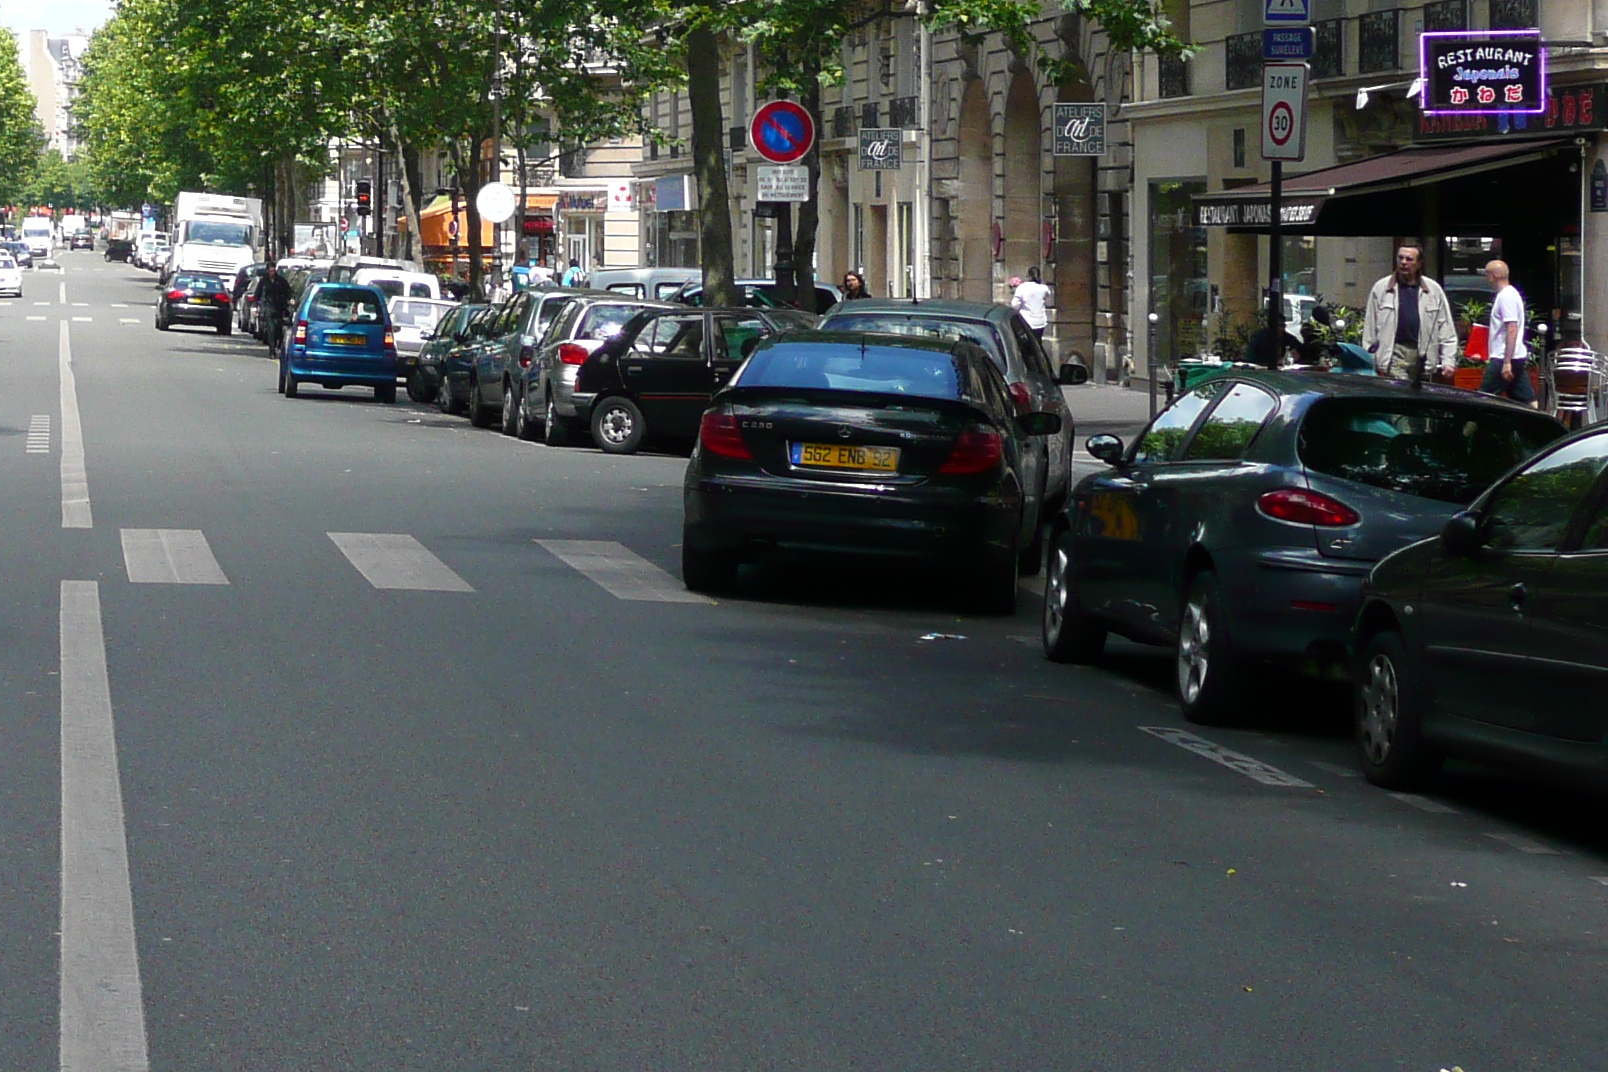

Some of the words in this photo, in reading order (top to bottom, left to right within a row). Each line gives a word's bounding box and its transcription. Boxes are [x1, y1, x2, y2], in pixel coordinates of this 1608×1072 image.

[1272, 32, 1303, 42] PASSAGE
[1437, 47, 1534, 69] RESTAURANT
[1453, 65, 1520, 83] Japonais
[1270, 76, 1298, 89] ZONE
[1450, 84, 1523, 104] かねだ
[1056, 106, 1103, 118] ATELIERS
[1273, 116, 1288, 131] 30
[861, 131, 899, 140] ATELIERS
[1056, 141, 1103, 153] FRANCE
[861, 159, 899, 169] FRANCE
[872, 450, 891, 468] 92
